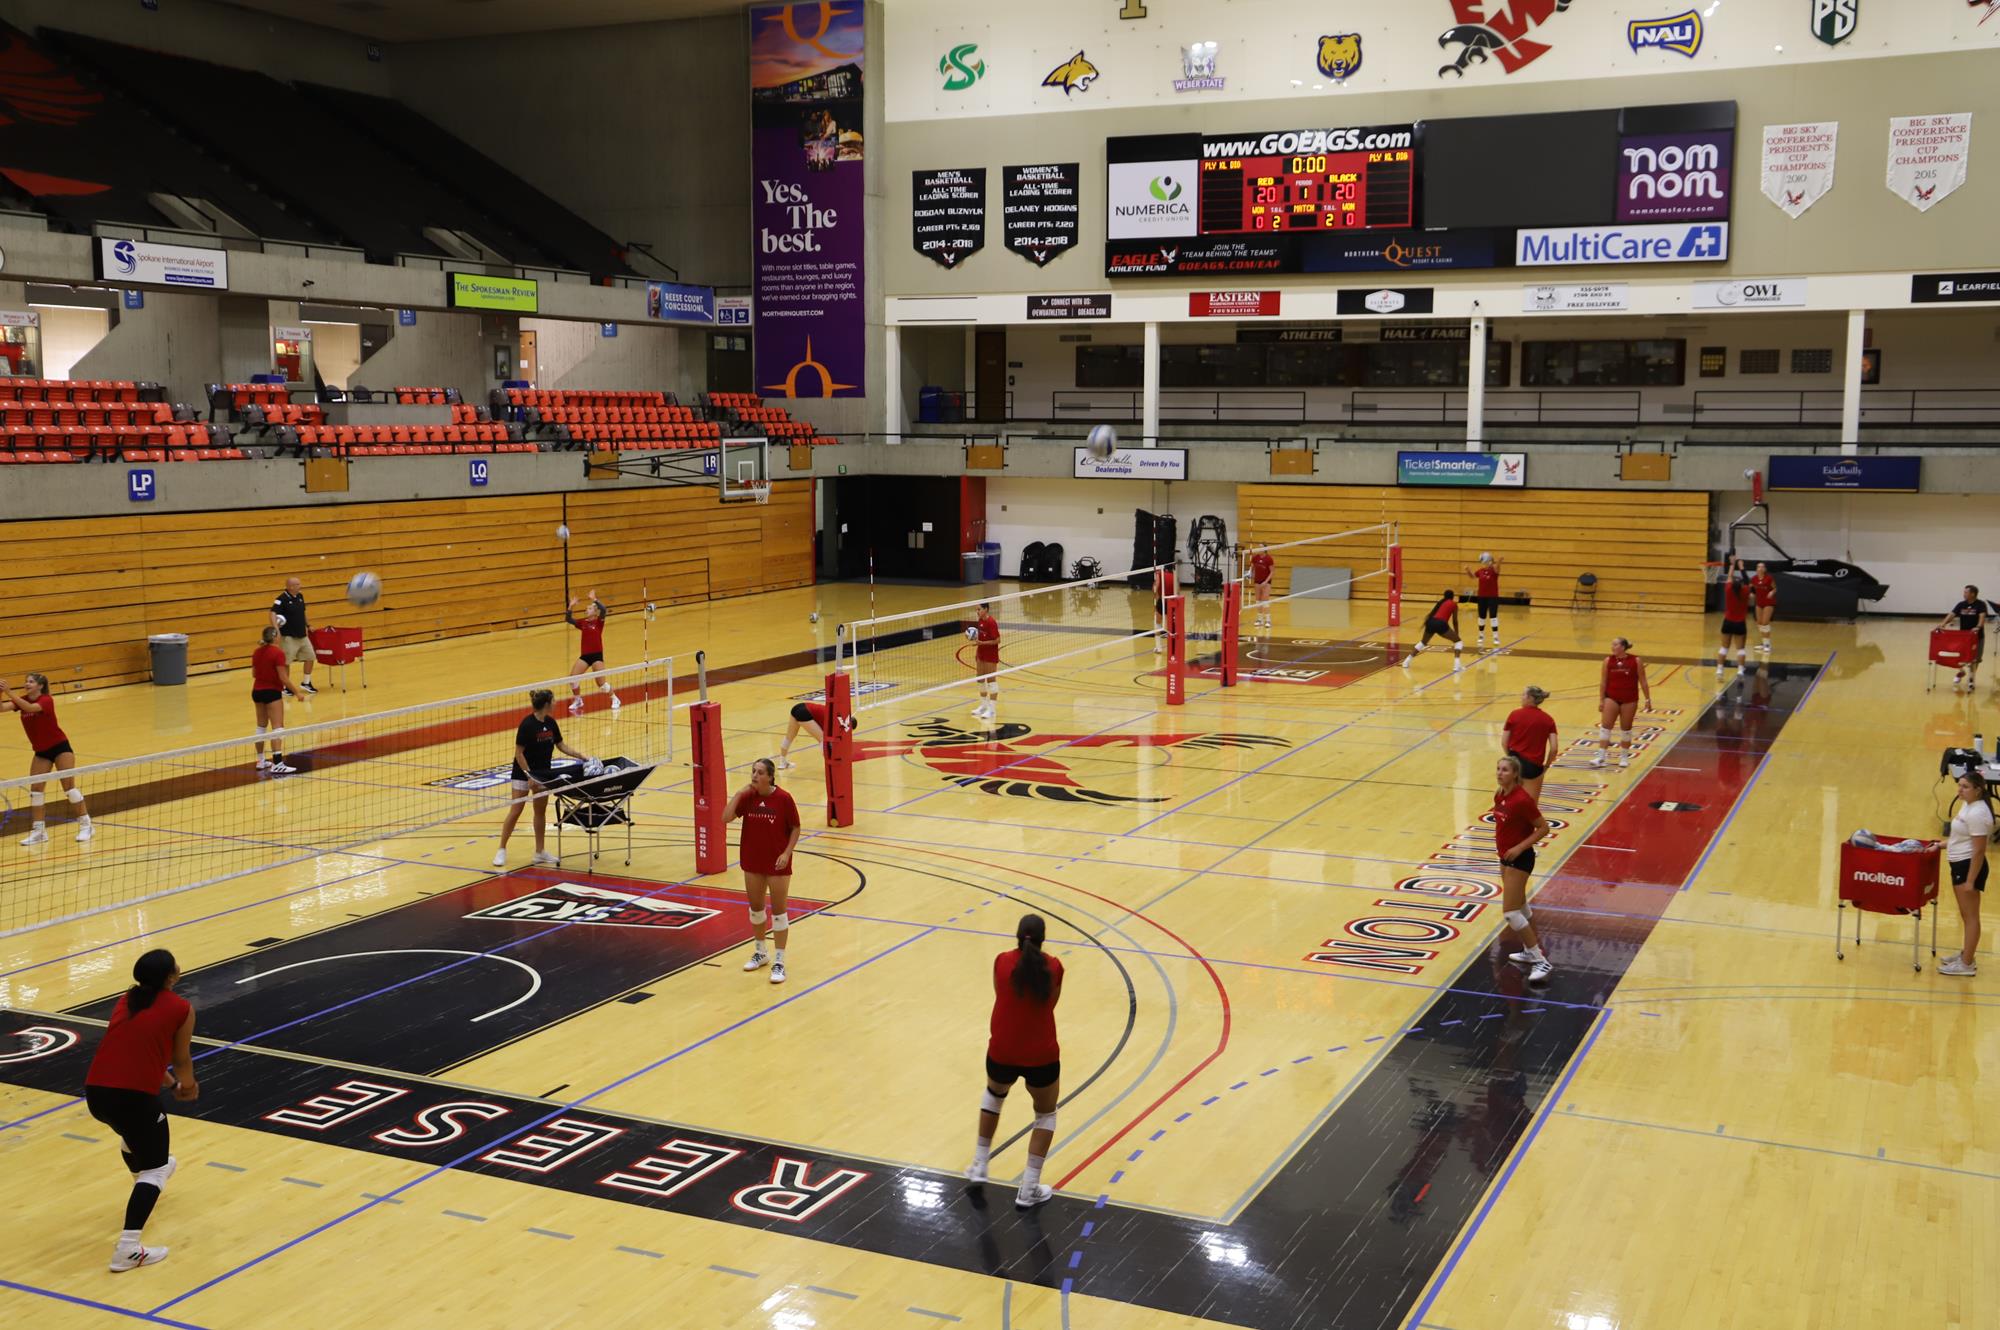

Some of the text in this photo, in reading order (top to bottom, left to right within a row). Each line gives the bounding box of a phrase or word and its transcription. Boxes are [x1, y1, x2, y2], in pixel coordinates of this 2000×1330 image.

[1637, 24, 1691, 44] NAU
[1175, 79, 1223, 89] WEBER STATE
[1909, 117, 1952, 127] BIG SKY
[1800, 126, 1818, 134] SKY
[1893, 126, 1966, 137] CONFERENCE
[1203, 129, 1411, 158] www.GOEAGS.com
[1766, 135, 1833, 144] CONFERENCE
[1895, 135, 1963, 146] PRESIDENT'S
[1769, 144, 1830, 154] PRESIDENT'S
[1917, 146, 1939, 154] CUP
[1623, 143, 1719, 173] nom
[1788, 154, 1808, 162] CUP
[1895, 154, 1960, 165] CHAMPIONS
[1022, 166, 1059, 174] WOMEN'S
[1292, 156, 1326, 174] 0:00
[1769, 162, 1826, 172] CHAMPIONS
[1016, 172, 1065, 181] BASKETBALL
[1329, 173, 1357, 182] BLACK
[1914, 170, 1937, 179] 2015
[924, 177, 973, 186] BASKETBALL
[1023, 182, 1059, 190] ALL-TIME
[1257, 177, 1274, 186] RED
[1629, 170, 1724, 200] nom
[760, 179, 809, 204] Yes.
[1009, 189, 1040, 197] LEADING
[1257, 187, 1276, 203] 20
[1335, 183, 1355, 200] 20
[919, 193, 949, 201] LEADING
[1005, 204, 1077, 213] DELANEY HODGINS
[1115, 203, 1190, 216] NUMERICA
[1252, 206, 1265, 214] WON
[1293, 204, 1315, 213] MATCH
[1342, 203, 1355, 211] WON
[1630, 205, 1714, 215] nomnomstore.com
[786, 202, 837, 230] The
[914, 208, 945, 217] BOGDAN
[1256, 216, 1263, 229] 0
[1272, 215, 1281, 229] 2
[1325, 213, 1334, 227] 2
[1346, 213, 1354, 226] 0
[917, 224, 944, 232] CAREER
[1008, 221, 1036, 229] CAREER
[761, 227, 822, 253] best.
[1213, 243, 1230, 251] JOIN
[1521, 232, 1672, 262] MultiCare
[1234, 249, 1249, 257] THE
[136, 253, 215, 268] Spokane International Airport
[1111, 253, 1160, 266] EAGLE
[1108, 264, 1167, 273] ATHLETIC FUND
[456, 281, 469, 292] THE
[1743, 284, 1782, 297] OWL
[665, 292, 703, 304] REESE COURT
[1050, 298, 1071, 306] CONNECT
[1209, 292, 1260, 302] EASTERN
[664, 302, 704, 313] CONCESSIONS
[1279, 330, 1336, 340] ATHLETIC
[1384, 329, 1417, 339] HALL
[1430, 328, 1467, 339] FAME
[1095, 466, 1132, 474] Dealerships
[1160, 461, 1168, 469] By
[472, 463, 487, 478] LQ
[132, 473, 152, 492] LP
[1854, 870, 1905, 887] molten
[262, 1078, 873, 1226] REESE
